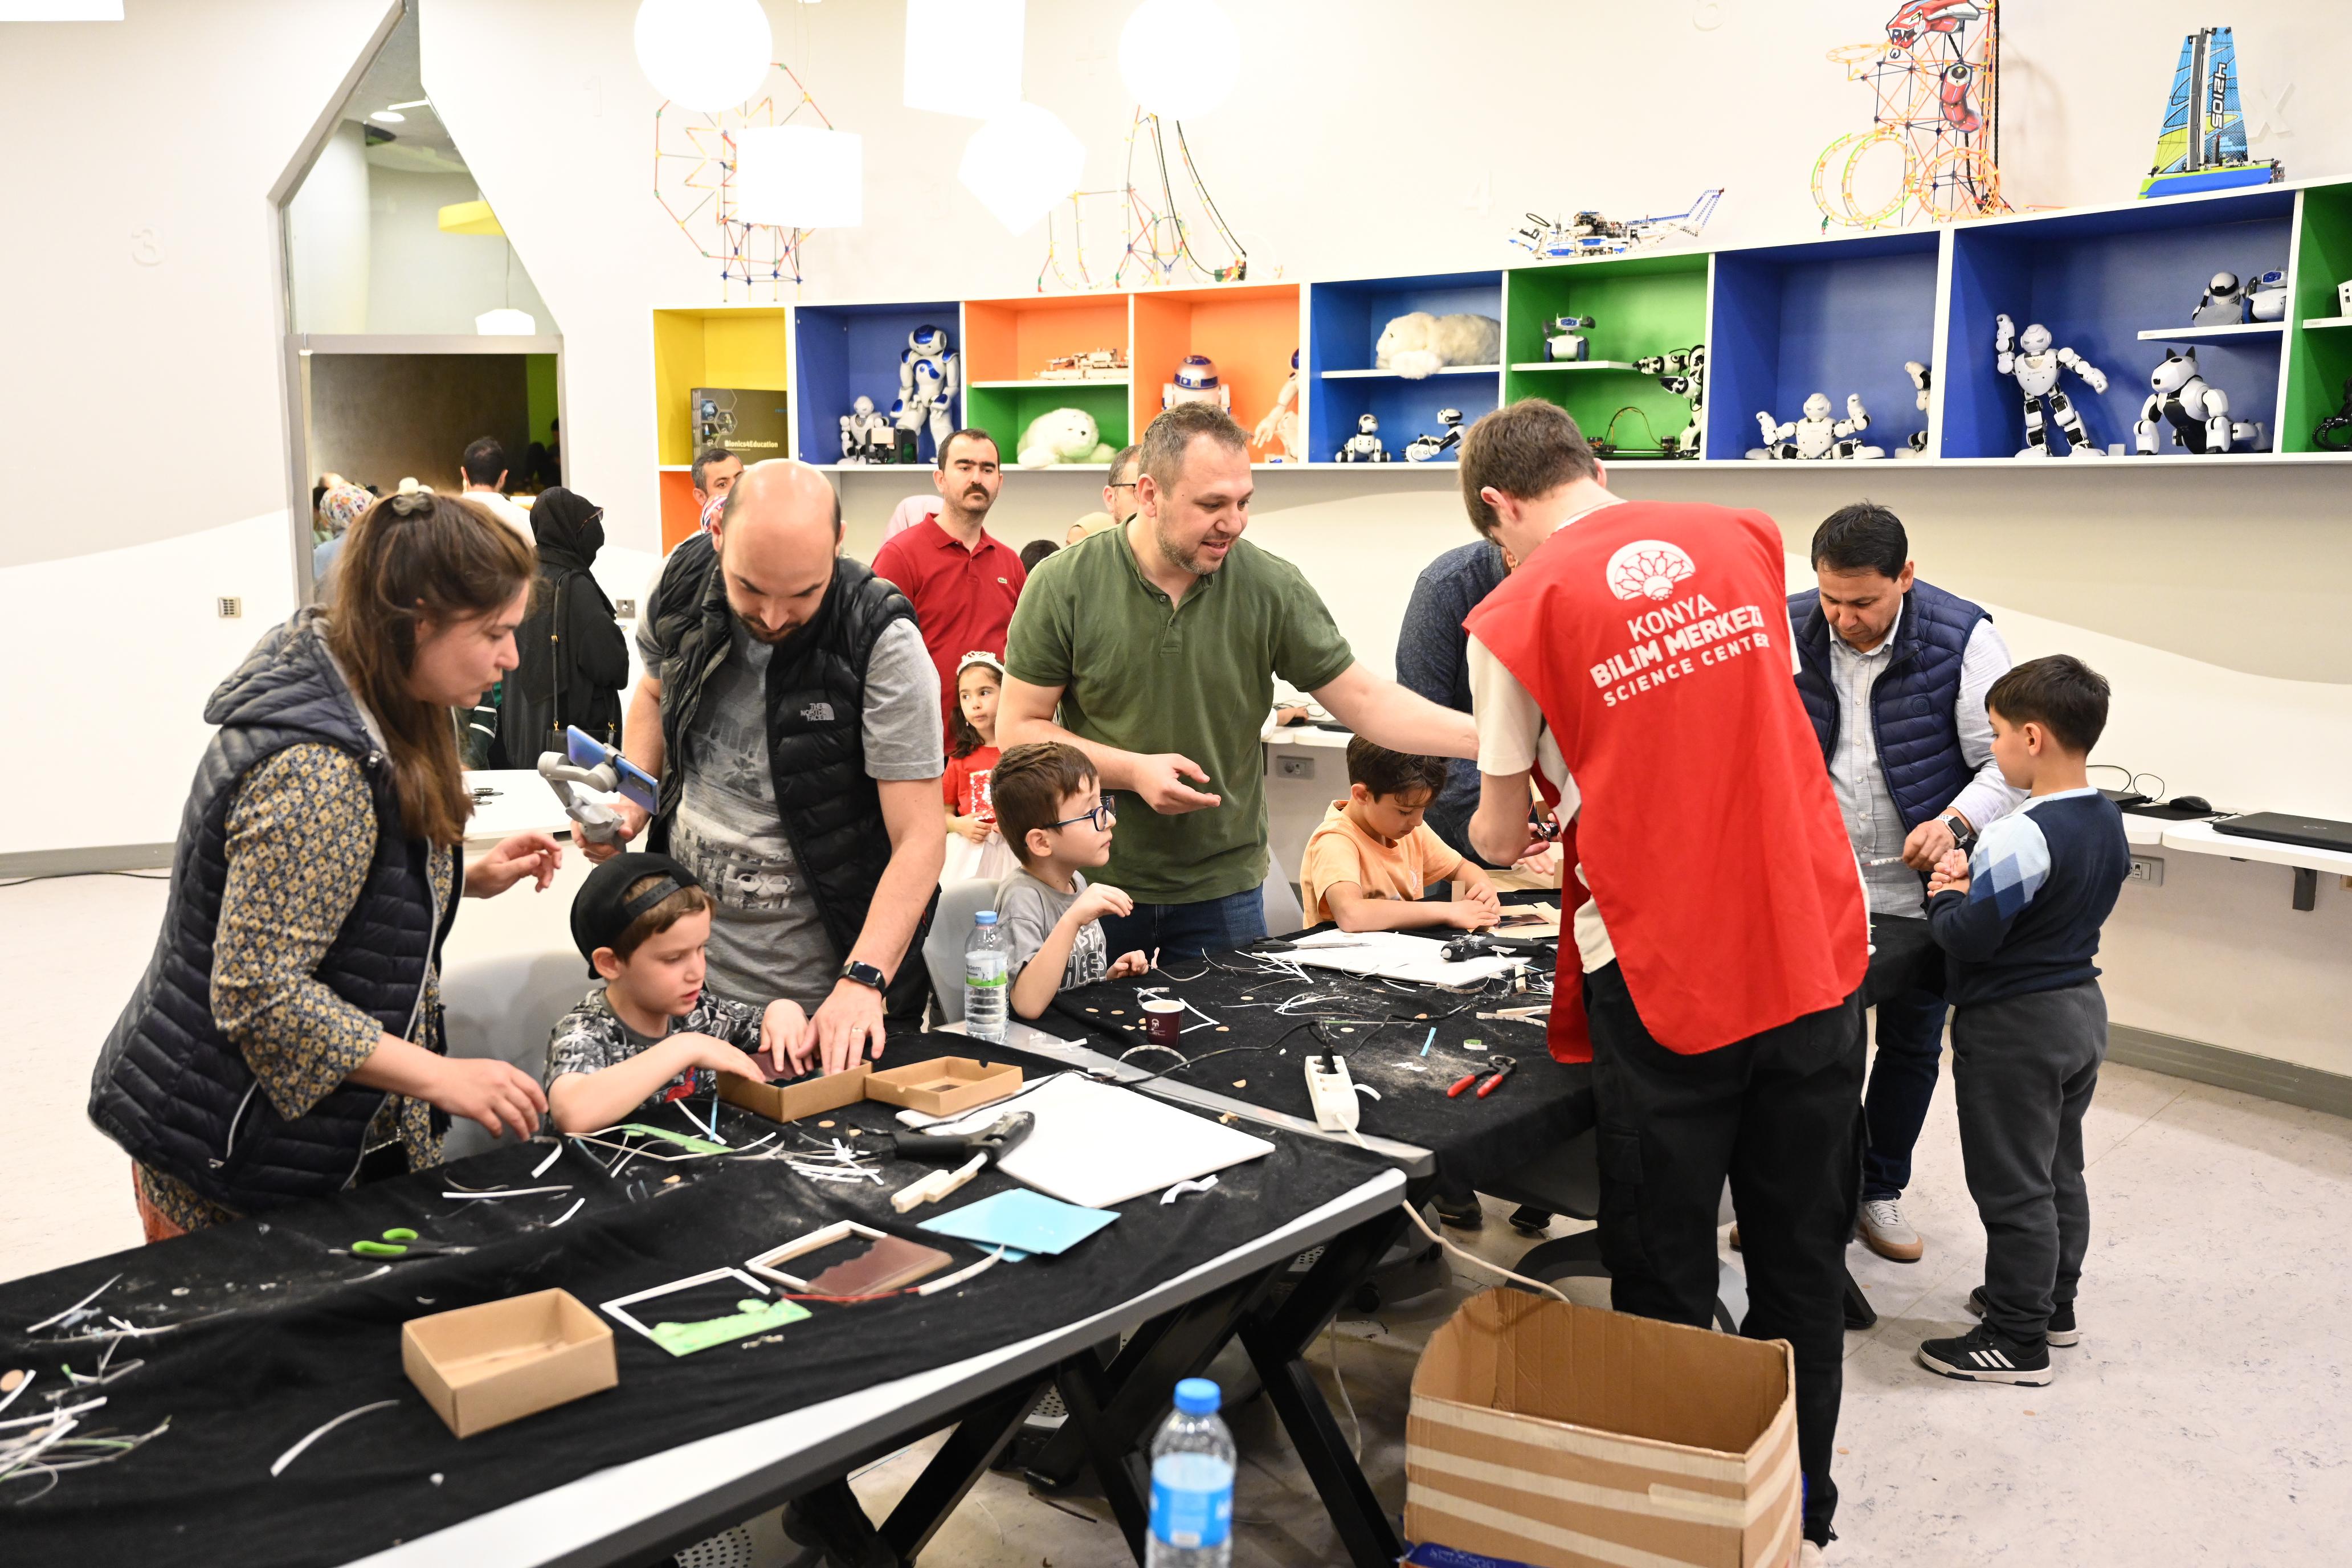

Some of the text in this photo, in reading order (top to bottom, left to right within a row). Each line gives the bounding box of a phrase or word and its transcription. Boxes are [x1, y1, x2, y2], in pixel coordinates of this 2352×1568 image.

[2212, 63, 2226, 128] 42105
[130, 223, 168, 267] 3
[724, 439, 778, 448] Bionics4Education
[1627, 594, 1717, 642] KONYA
[1603, 632, 1770, 707] SCIENCE CENTER
